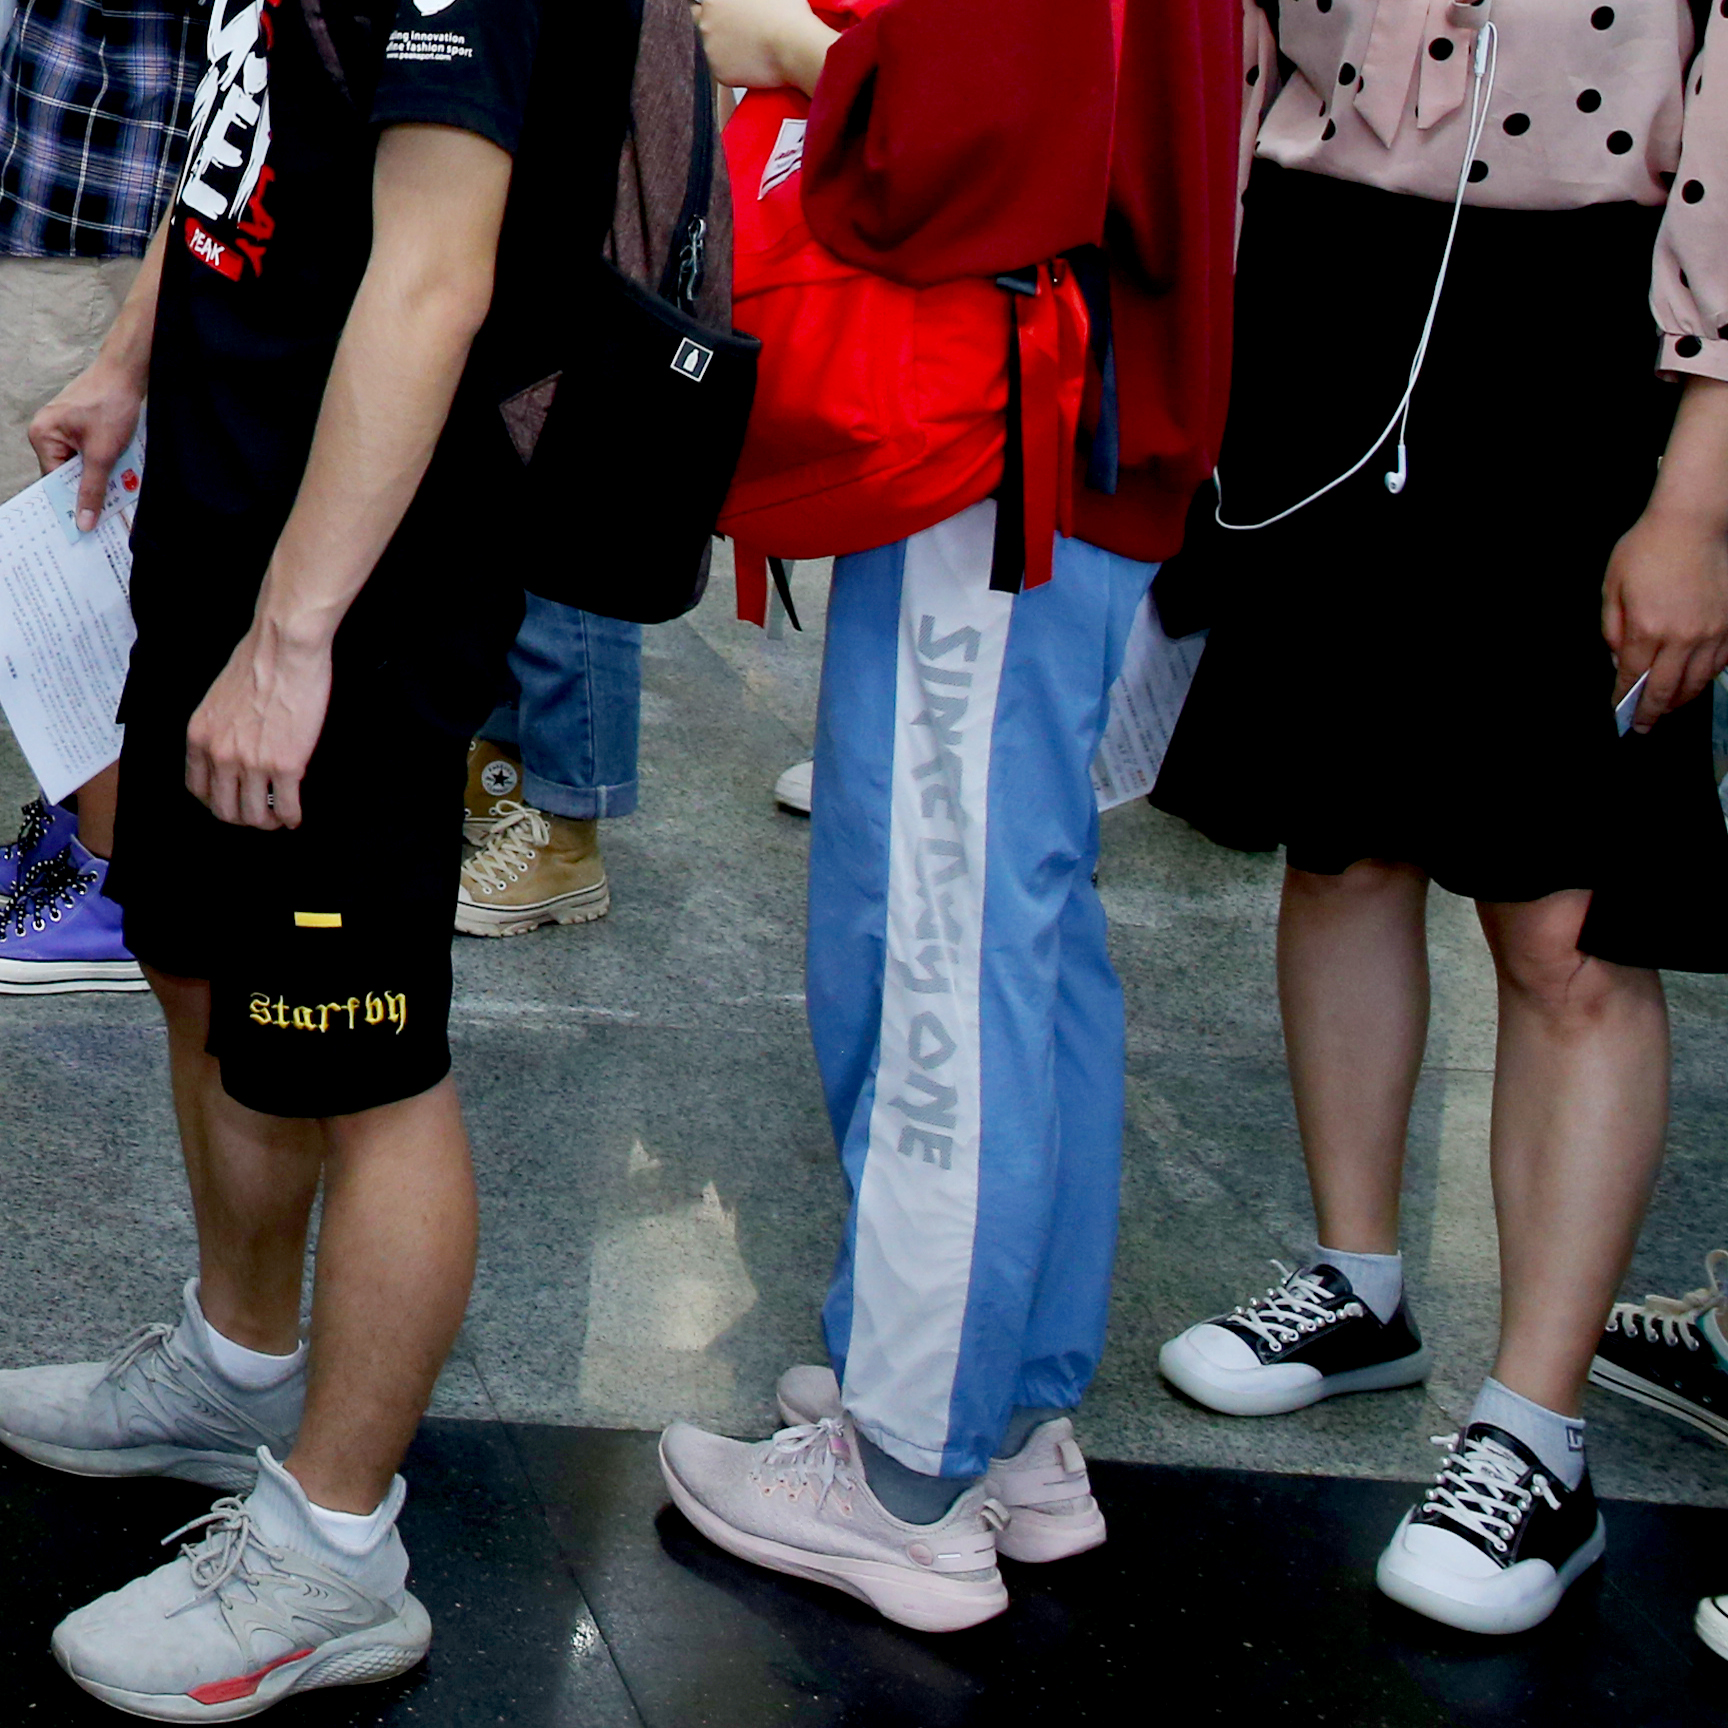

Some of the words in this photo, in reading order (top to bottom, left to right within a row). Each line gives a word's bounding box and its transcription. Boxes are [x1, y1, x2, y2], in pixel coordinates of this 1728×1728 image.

[406, 40, 445, 53] fashion
[446, 44, 473, 58] sport
[411, 30, 465, 44] innovation
[189, 227, 226, 267] PEAK
[888, 1010, 958, 1170] ONE
